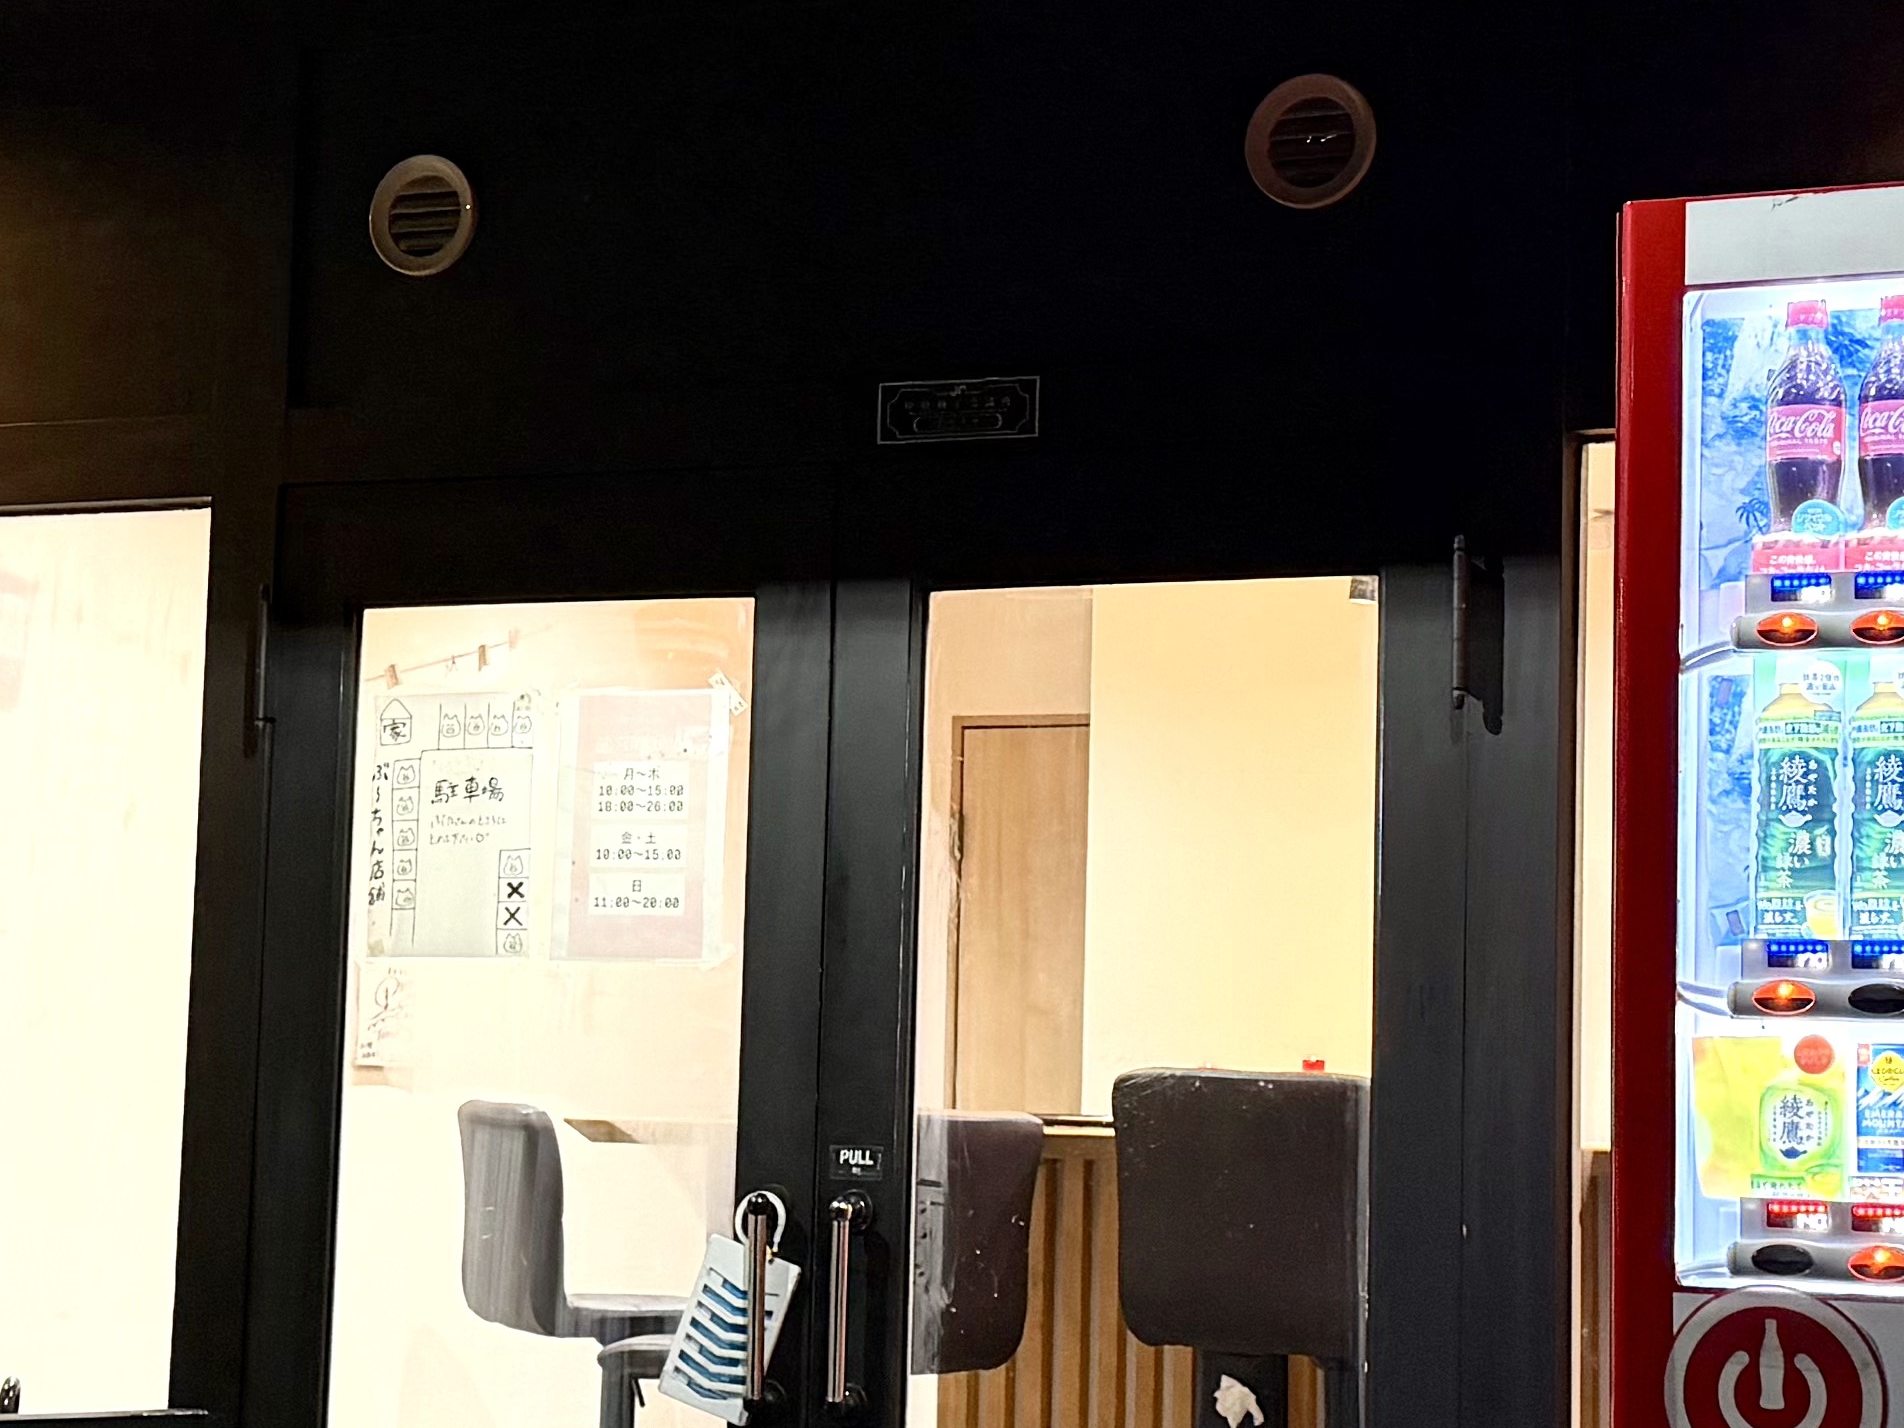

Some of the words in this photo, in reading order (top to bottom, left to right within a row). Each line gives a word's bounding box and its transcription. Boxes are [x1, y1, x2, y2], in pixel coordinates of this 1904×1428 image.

[381, 718, 409, 742] 家
[431, 776, 505, 804] 駐車場
[1780, 754, 1807, 810] 綾鷹
[1874, 753, 1904, 810] 綾鷹
[632, 879, 643, 892] 日
[1779, 1094, 1805, 1144] 綾鷹
[839, 1149, 875, 1166] PULL
